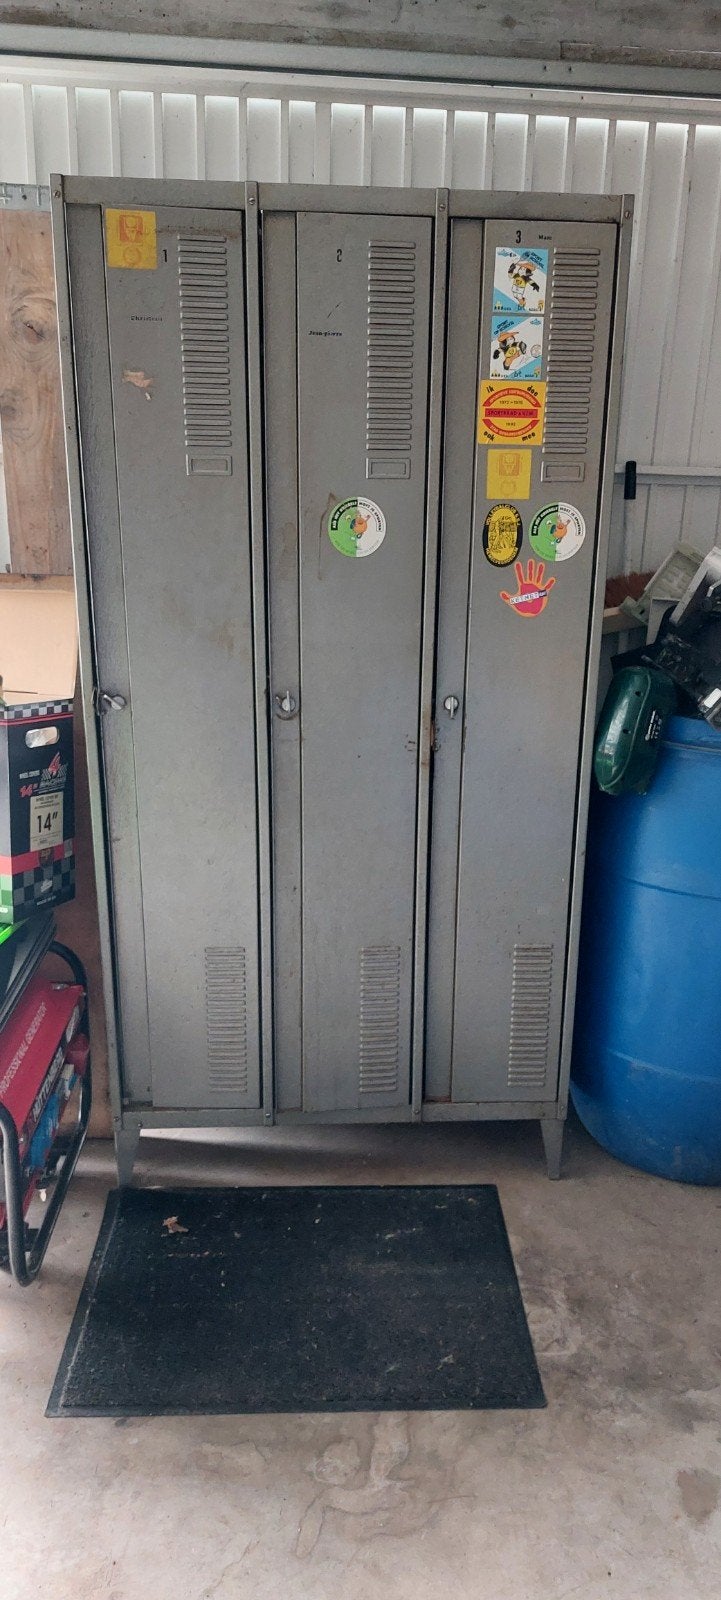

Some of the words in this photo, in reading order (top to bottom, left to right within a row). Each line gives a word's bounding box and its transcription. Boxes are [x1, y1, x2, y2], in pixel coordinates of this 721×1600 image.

[515, 230, 522, 244] 3
[162, 249, 168, 263] 1
[336, 248, 343, 262] 2
[486, 385, 495, 394] ik
[526, 385, 539, 397] doe
[483, 430, 496, 442] ook
[521, 431, 536, 442] mee
